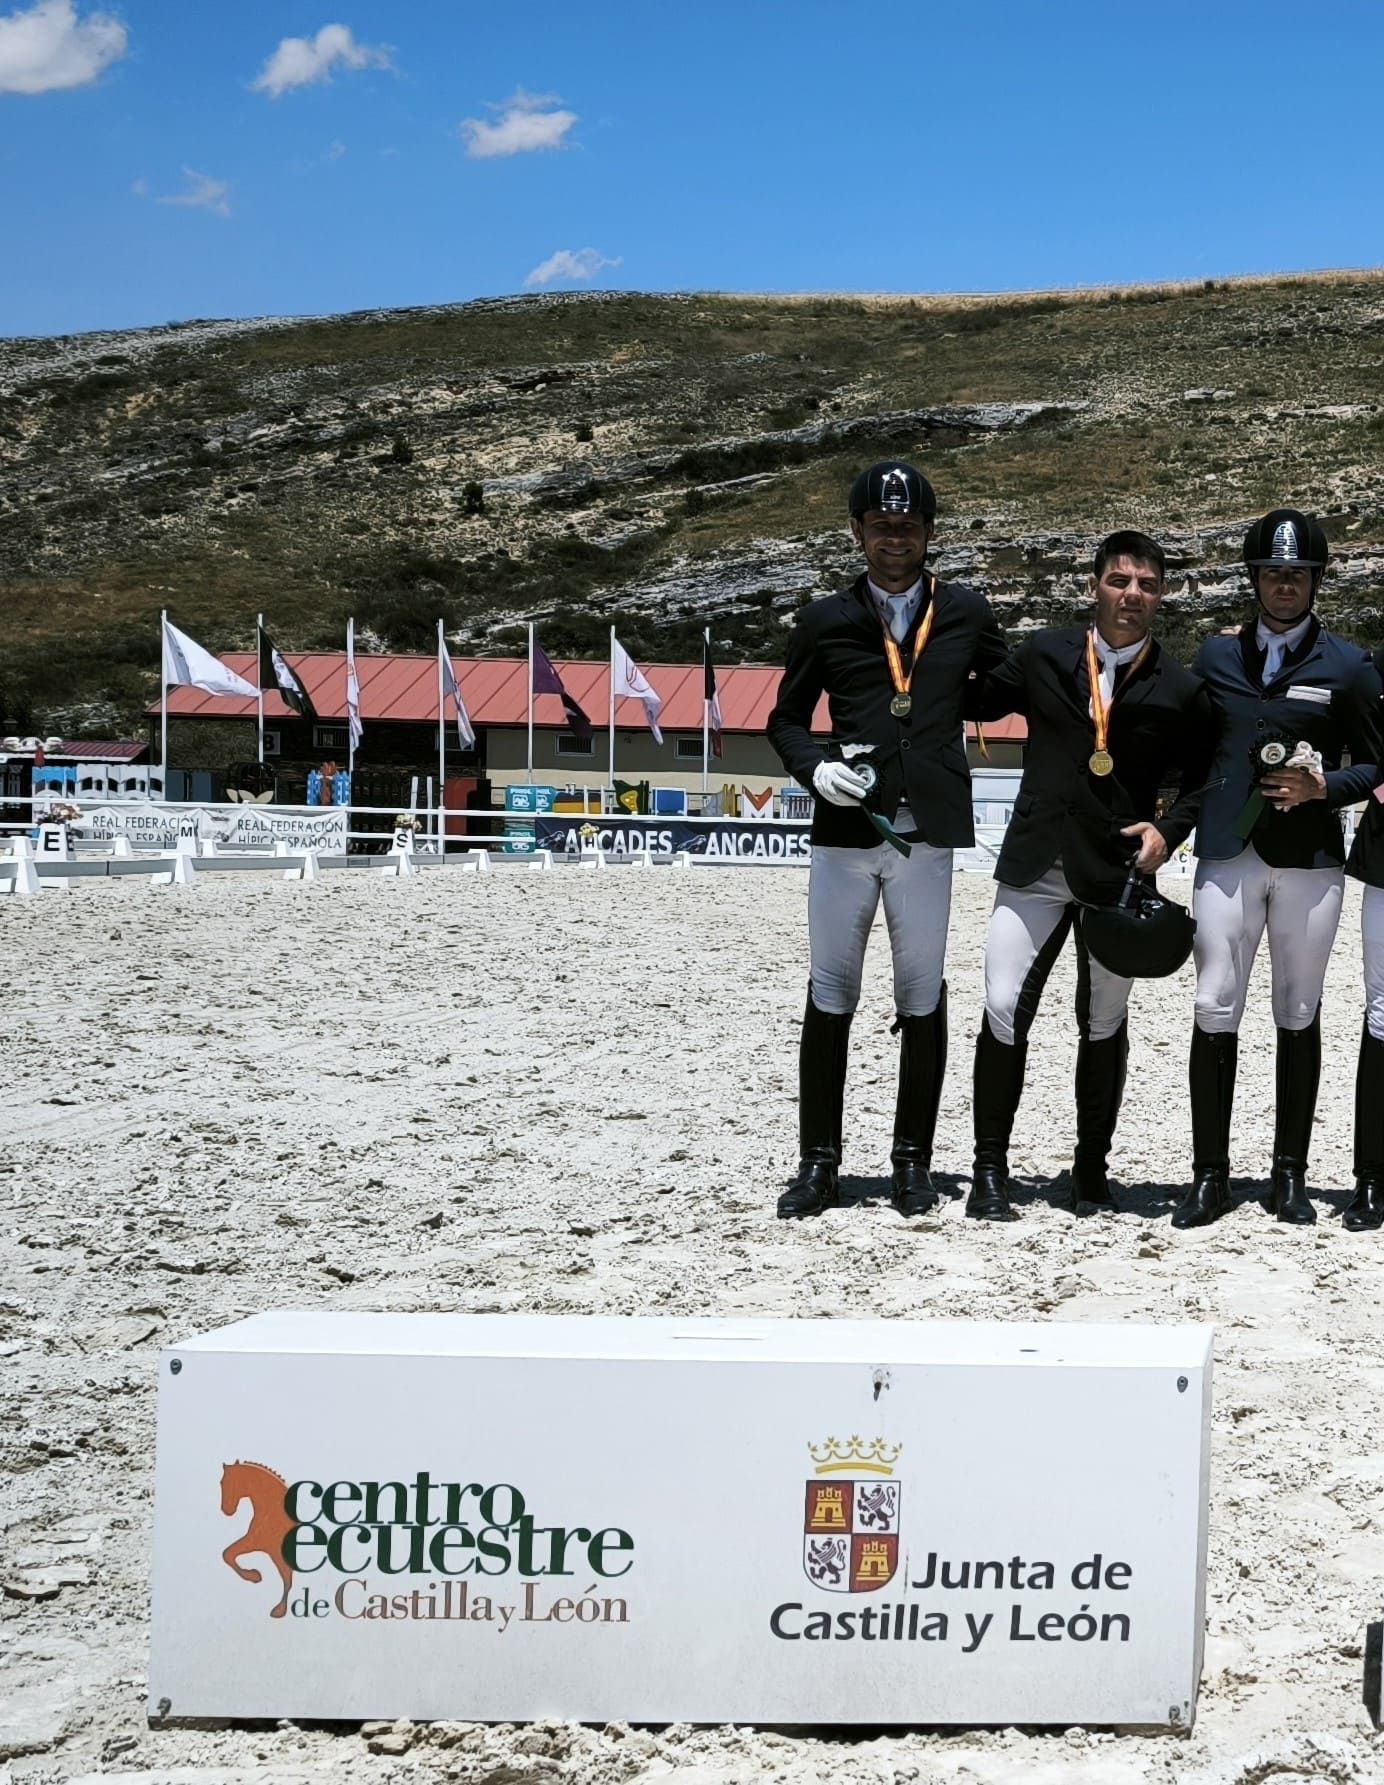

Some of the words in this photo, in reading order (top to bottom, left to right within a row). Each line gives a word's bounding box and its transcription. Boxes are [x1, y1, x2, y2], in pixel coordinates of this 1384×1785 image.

[92, 815, 121, 828] REAL
[180, 826, 192, 837] M
[237, 819, 268, 831] REAL
[44, 831, 60, 852] E
[396, 833, 409, 848] S
[564, 828, 673, 854] ACADES
[585, 837, 595, 848] H
[705, 831, 813, 858] ANCADES
[1179, 852, 1188, 863] C
[284, 1471, 526, 1527] centro
[281, 1515, 635, 1578] ecuestre
[912, 1552, 1055, 1591] Junta
[1071, 1553, 1133, 1591] de
[290, 1587, 330, 1619] de
[334, 1578, 495, 1621] Castilla
[495, 1606, 517, 1633] y
[519, 1582, 630, 1623] León
[770, 1602, 949, 1642] Castilla
[961, 1613, 994, 1653] y
[1009, 1604, 1131, 1642] León
